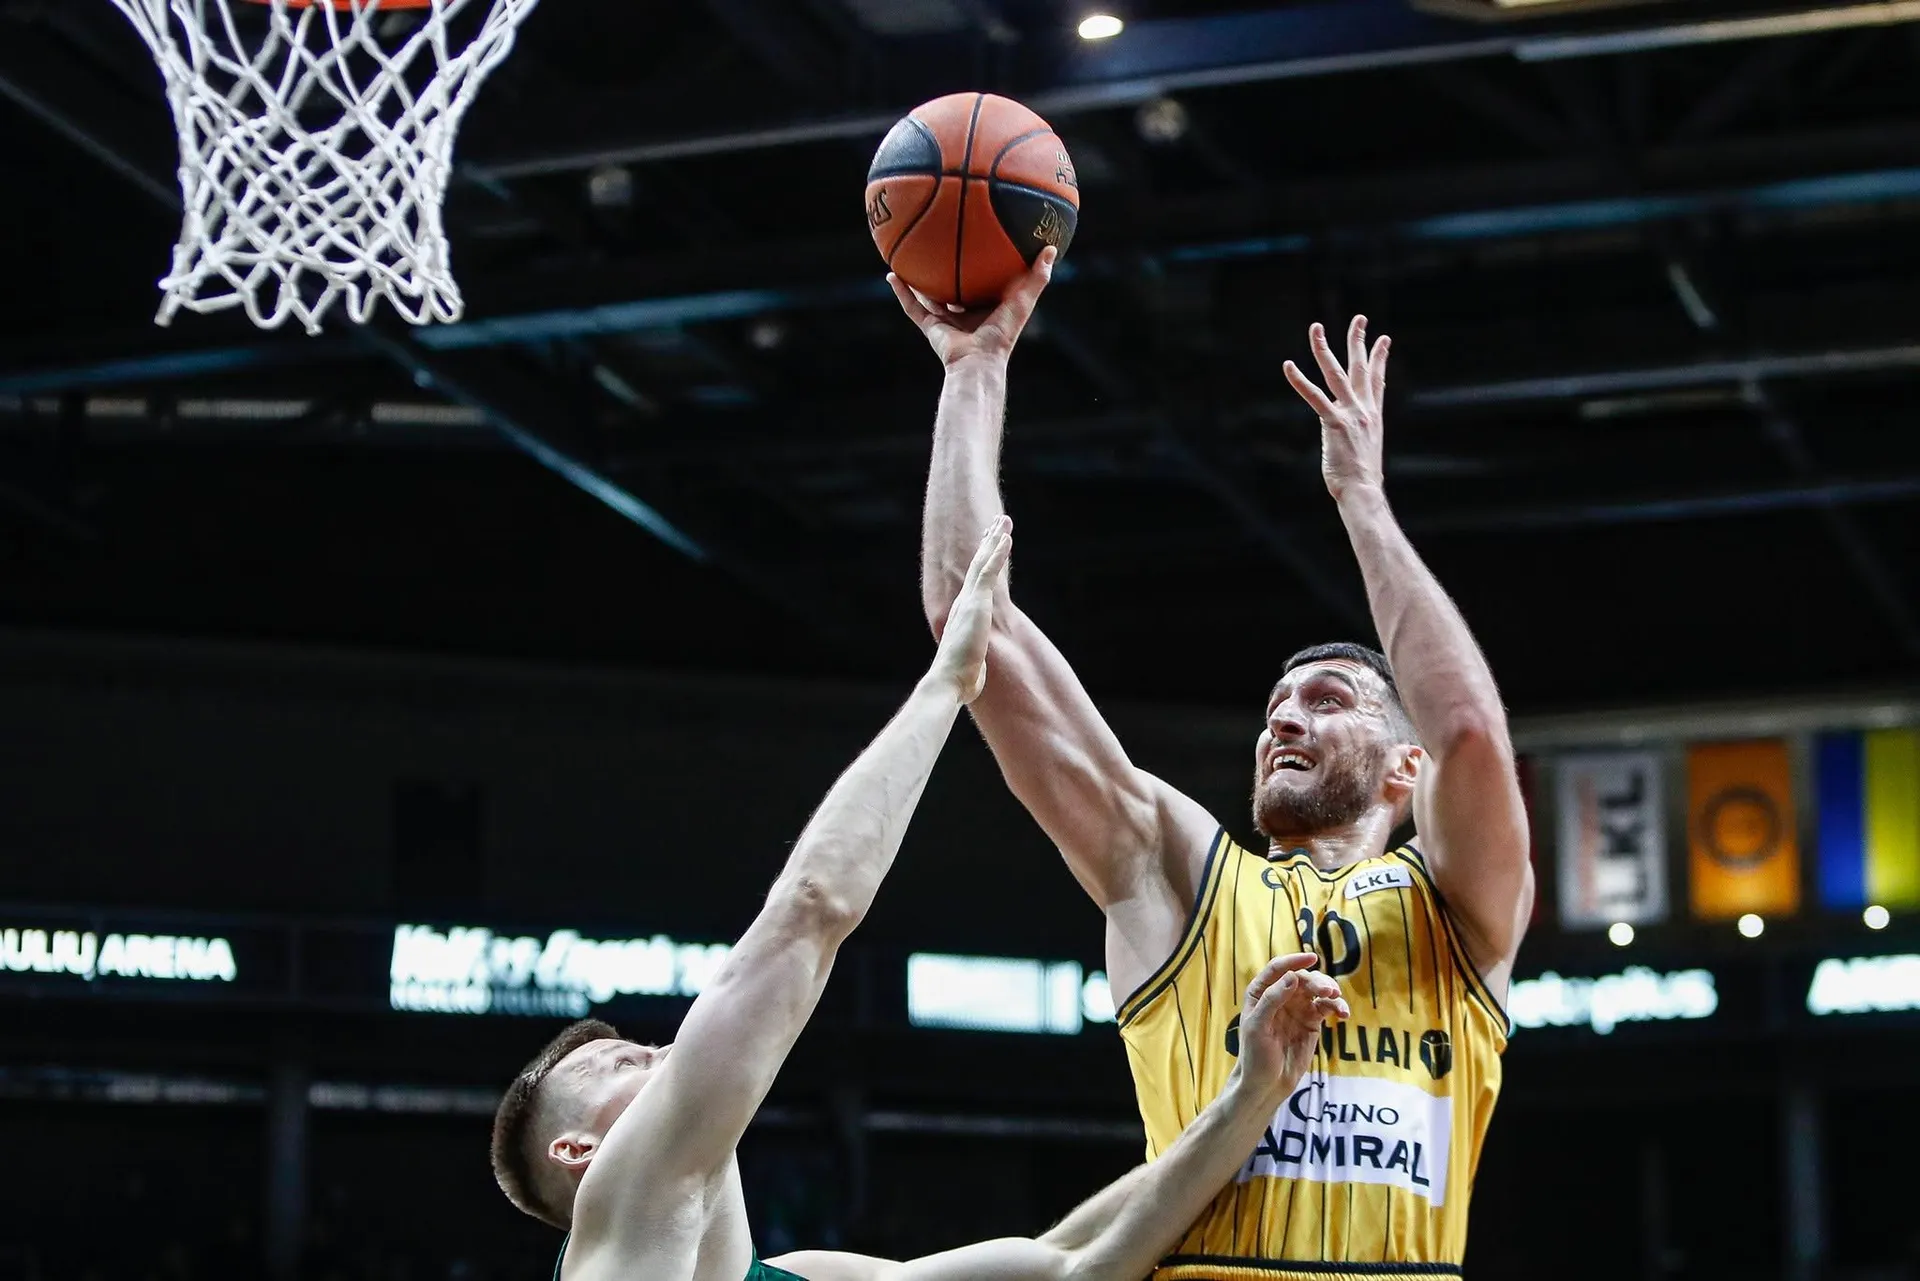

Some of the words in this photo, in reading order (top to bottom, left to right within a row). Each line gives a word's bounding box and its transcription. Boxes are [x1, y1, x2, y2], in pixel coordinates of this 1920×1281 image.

[1353, 872, 1400, 892] LKL
[0, 927, 98, 981] ULIŲ
[98, 933, 238, 982] ARENA
[1249, 1124, 1430, 1187] ADMIRAL
